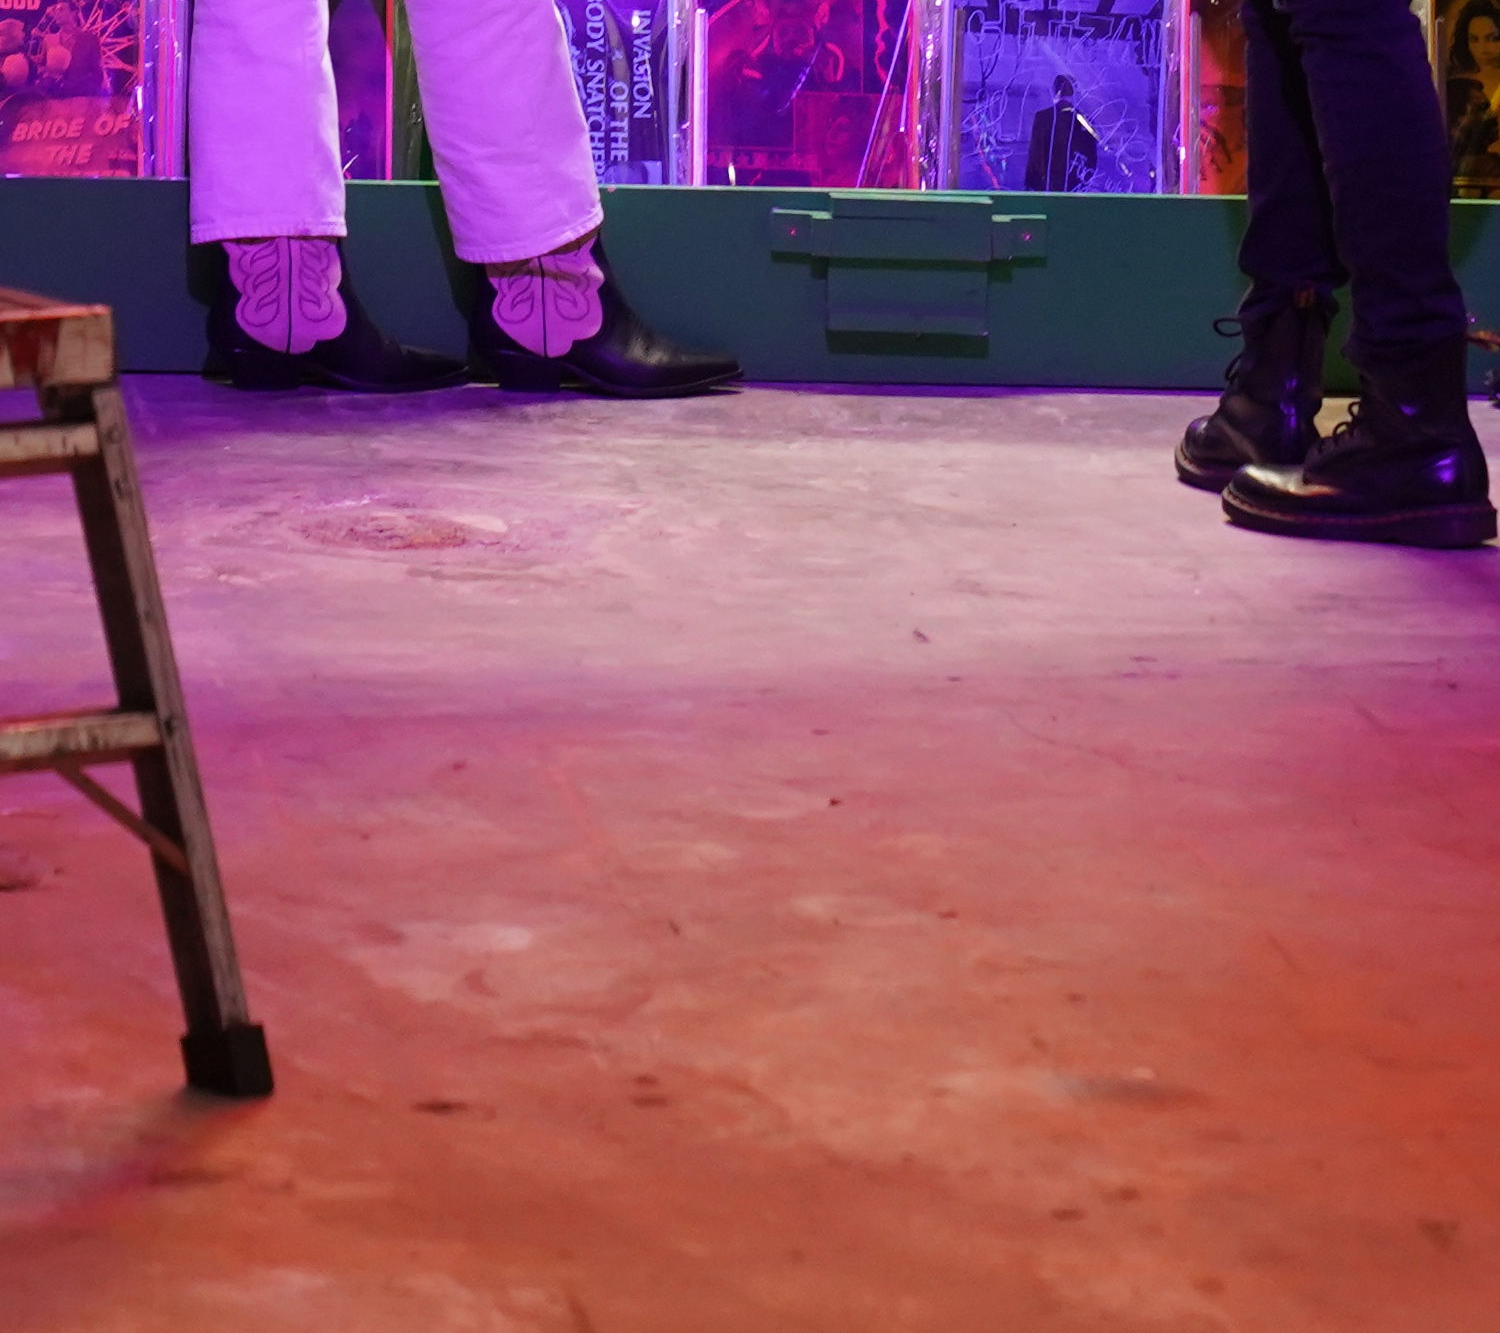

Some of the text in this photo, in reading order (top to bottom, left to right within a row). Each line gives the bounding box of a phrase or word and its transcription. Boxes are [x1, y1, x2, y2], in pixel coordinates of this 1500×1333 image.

[632, 9, 653, 120] INVASION
[12, 114, 131, 144] BRIDE OF
[608, 80, 629, 163] OF THE
[46, 144, 93, 166] THE
